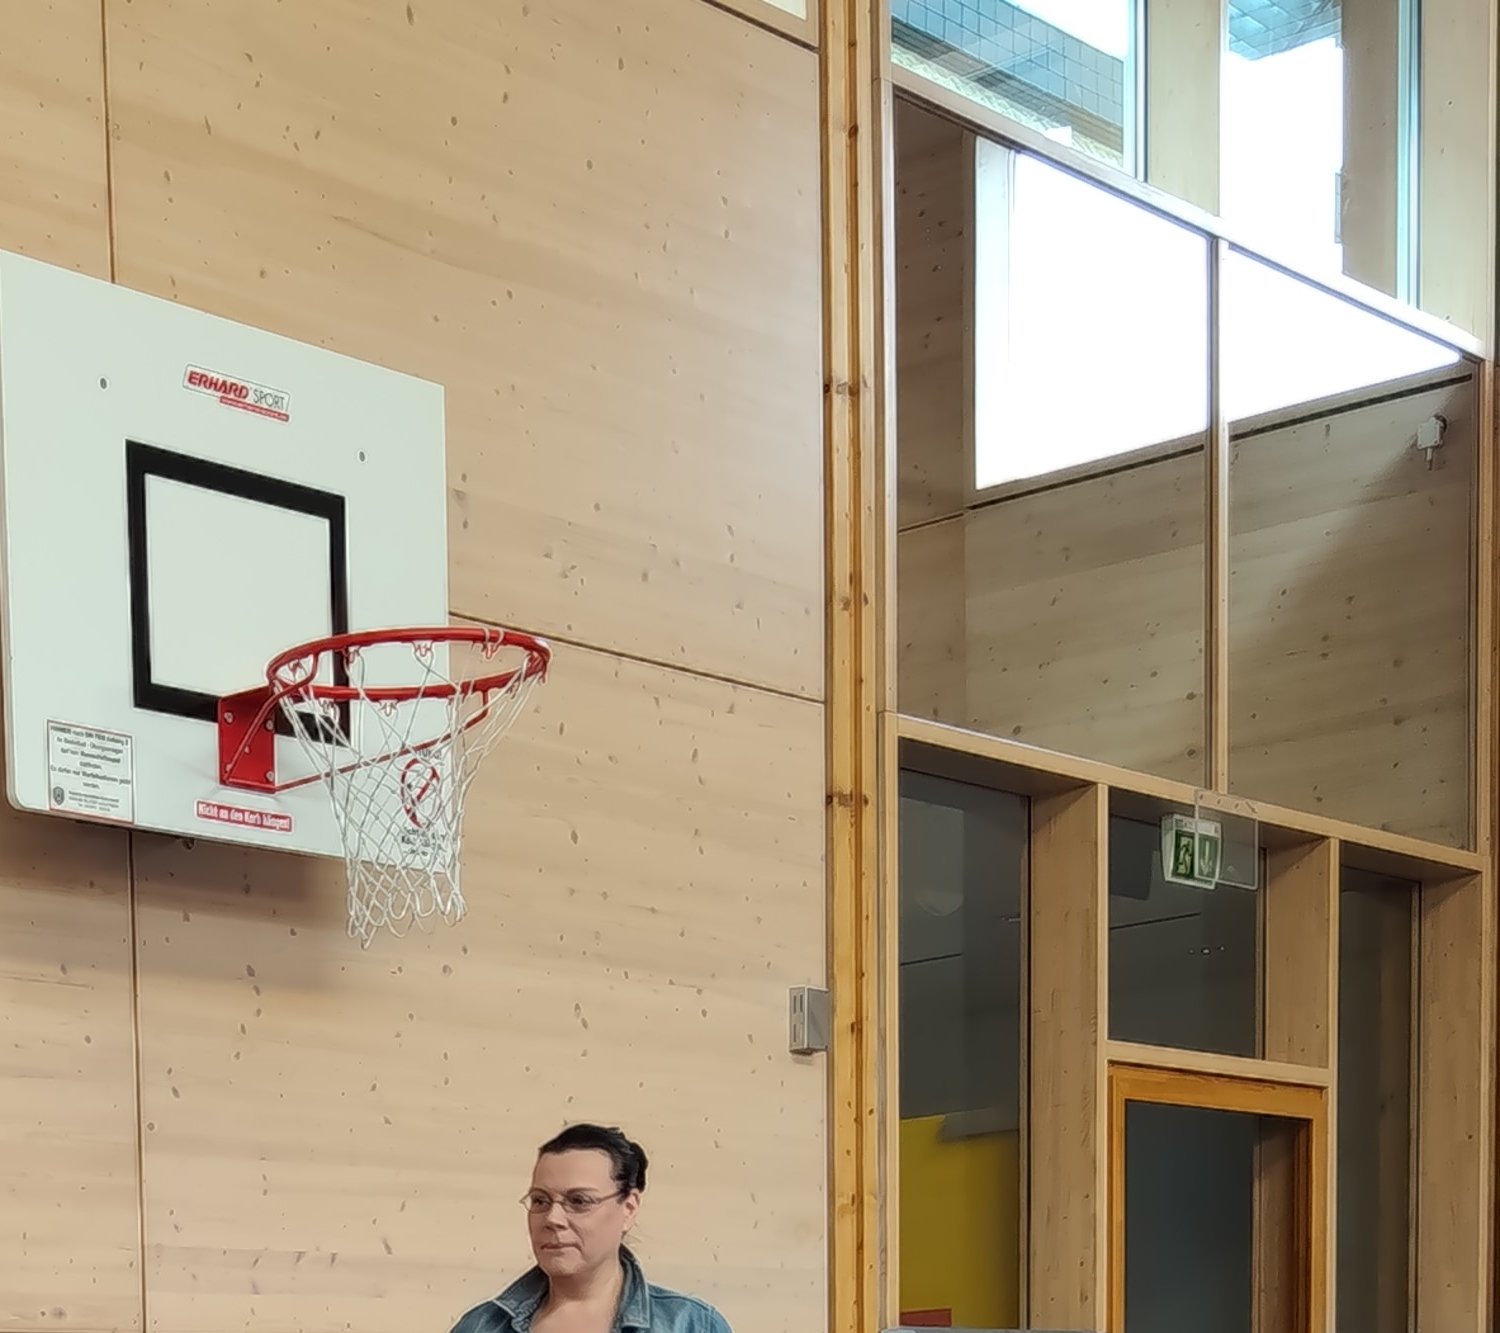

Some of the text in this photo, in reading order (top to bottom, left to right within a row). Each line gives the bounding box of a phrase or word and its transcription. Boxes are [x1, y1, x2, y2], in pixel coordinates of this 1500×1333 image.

[188, 371, 249, 399] ERHARD
[253, 388, 285, 410] SPORT
[198, 803, 218, 817] Nicht
[219, 809, 228, 819] an
[230, 809, 243, 822] den
[244, 811, 261, 825] Korb
